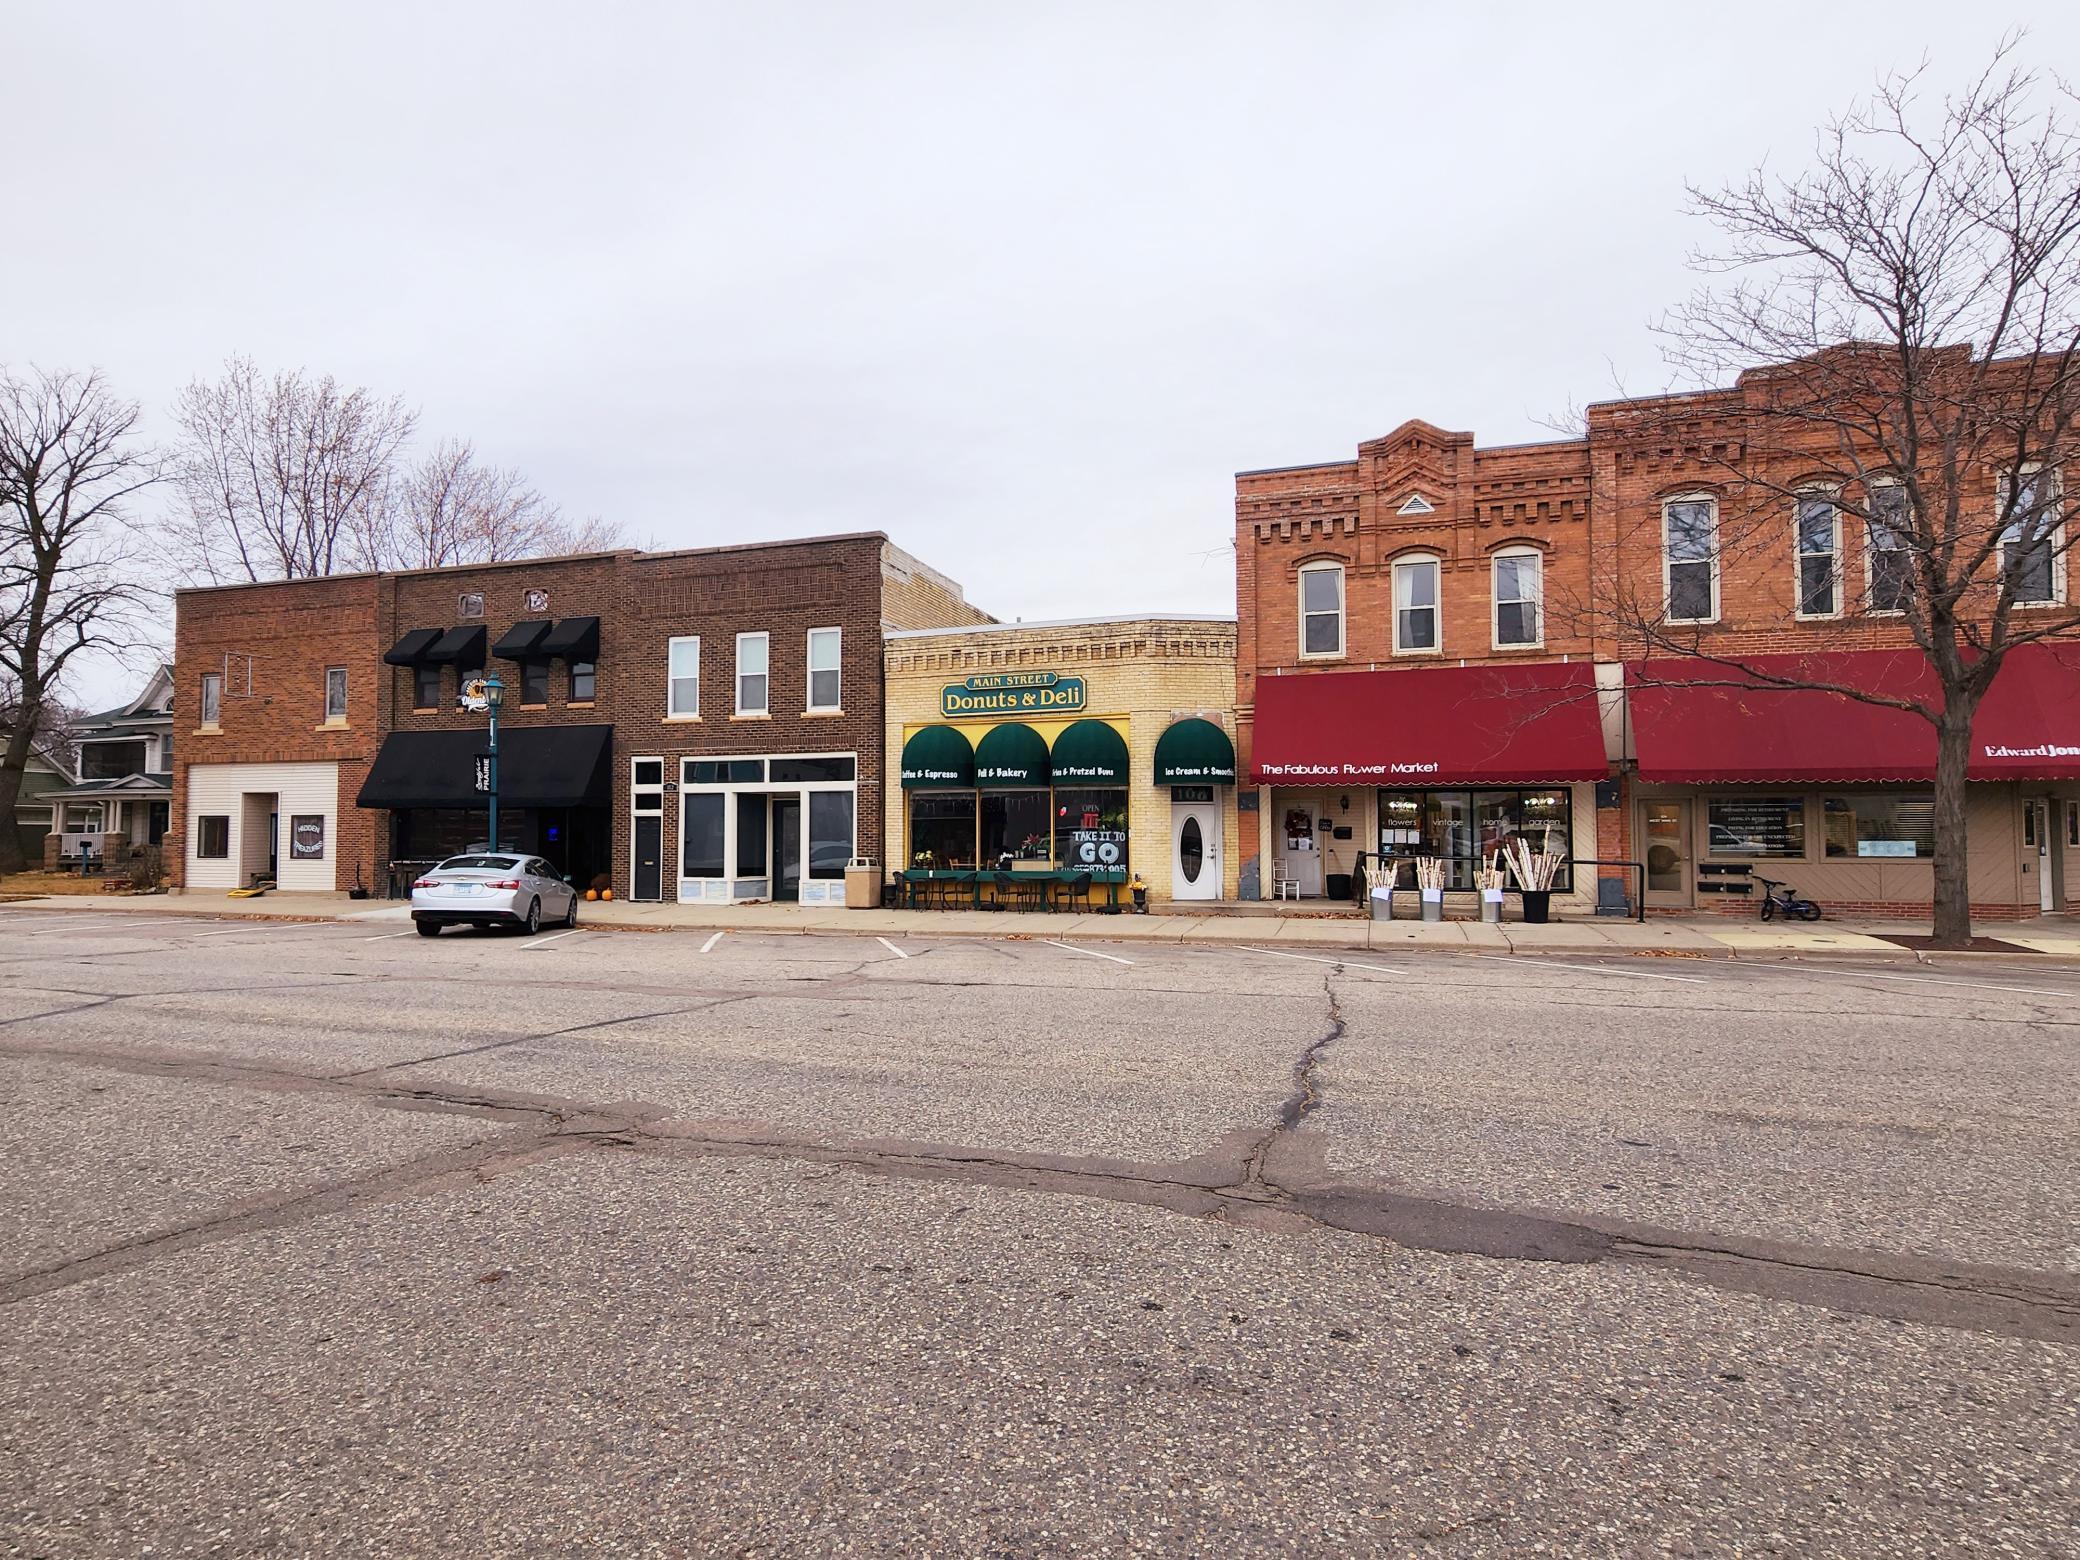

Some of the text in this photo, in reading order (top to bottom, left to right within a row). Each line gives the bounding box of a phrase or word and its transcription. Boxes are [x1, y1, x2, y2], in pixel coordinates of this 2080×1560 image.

[973, 674, 1049, 687] MAIN STREET
[946, 687, 1080, 710] Donuts & Deli
[1984, 744, 2080, 757] Edward Jon
[988, 768, 995, 778] &
[996, 767, 1028, 779] Bakery
[1069, 766, 1096, 776] Pretzel
[1097, 767, 1114, 776] Buns
[1165, 767, 1174, 776] Ice
[1175, 767, 1201, 776] Cream
[1202, 766, 1210, 775] &
[1261, 762, 1439, 774] The Fabulous Flower Market
[917, 769, 924, 778] &
[924, 769, 958, 780] Espresso
[1388, 818, 1417, 826] flowers
[1432, 819, 1464, 827] vintage
[1482, 818, 1509, 826] home
[1528, 818, 1561, 828] garden
[297, 824, 320, 834] HIDDEN
[1072, 831, 1126, 842] TAKE IT TO
[1079, 842, 1120, 864] GO
